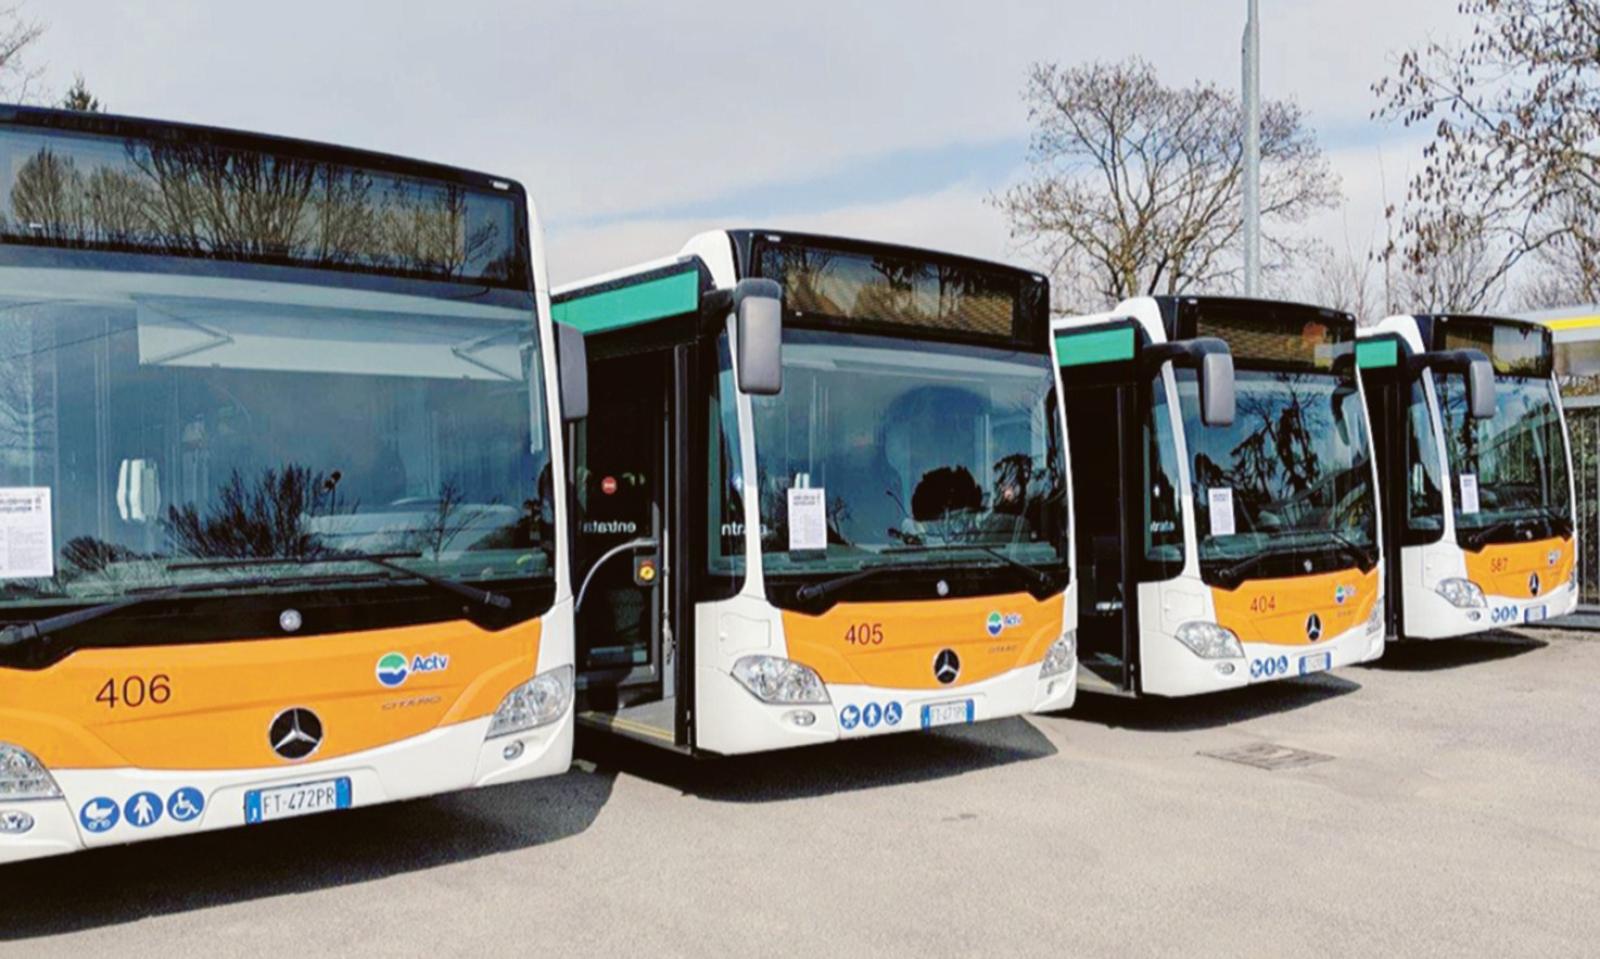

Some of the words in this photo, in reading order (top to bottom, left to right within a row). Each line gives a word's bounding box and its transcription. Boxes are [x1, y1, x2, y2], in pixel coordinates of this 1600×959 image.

[1250, 595, 1275, 613] 404
[844, 622, 884, 646] 405
[411, 655, 448, 672] Actv
[95, 674, 171, 709] 406
